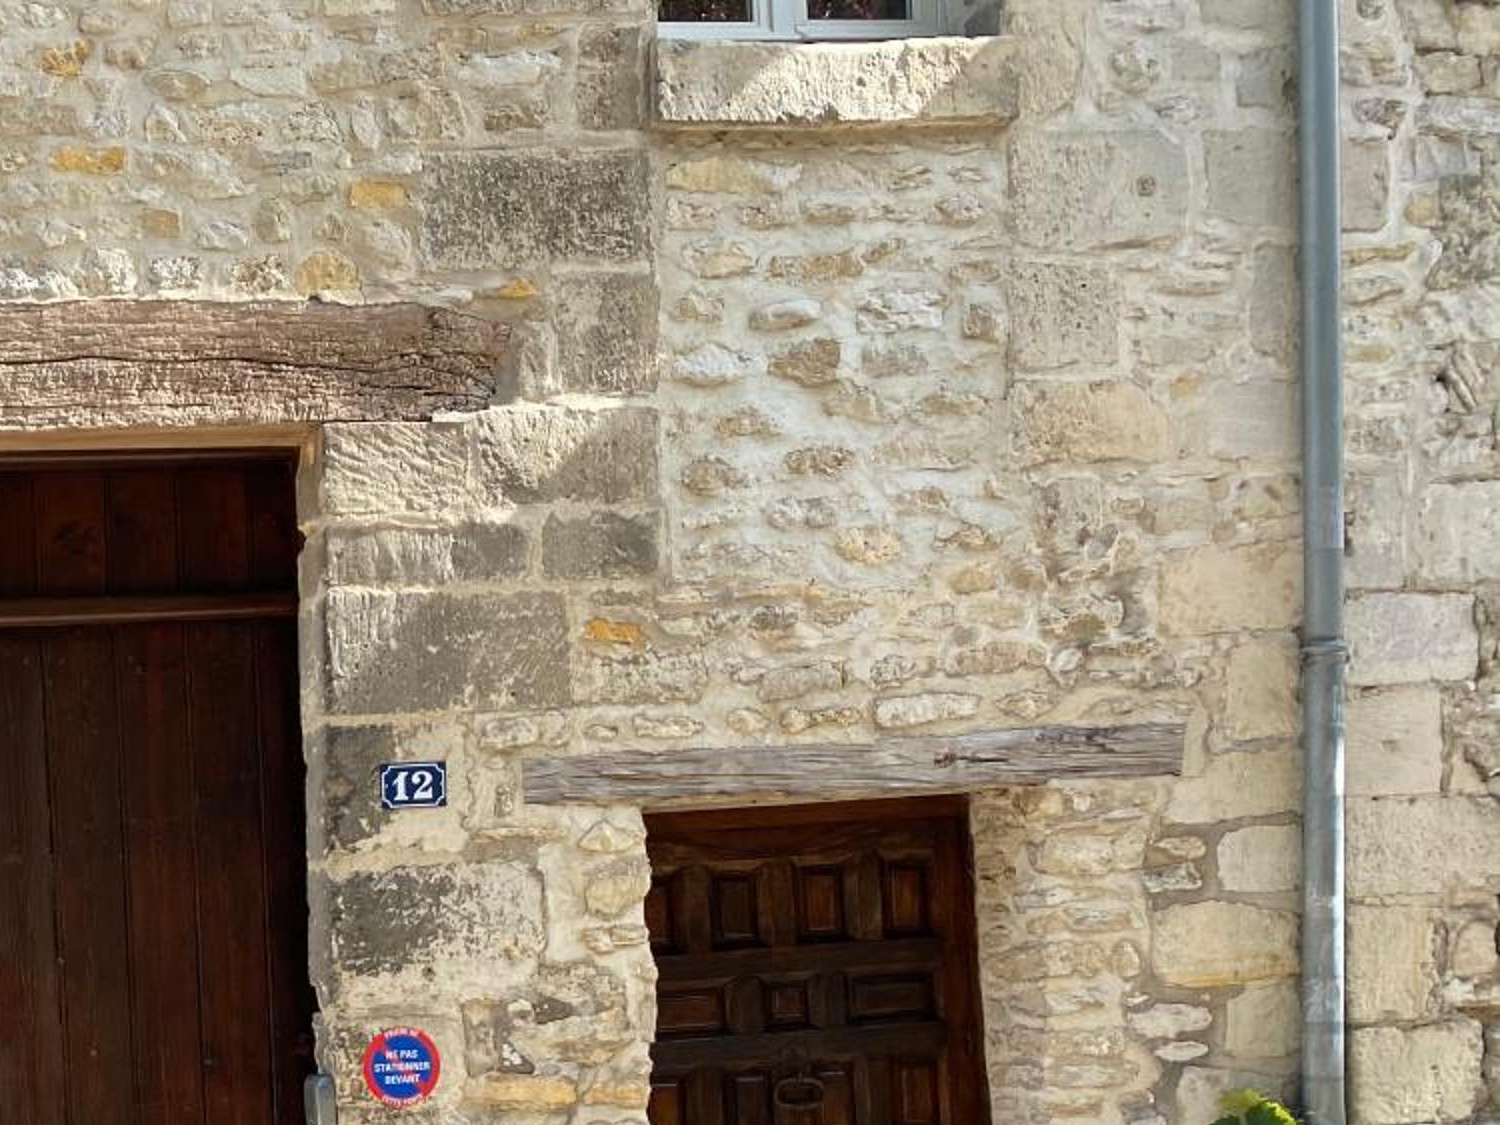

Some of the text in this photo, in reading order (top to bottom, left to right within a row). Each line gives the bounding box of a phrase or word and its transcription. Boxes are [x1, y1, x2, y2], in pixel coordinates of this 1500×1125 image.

[392, 770, 433, 801] 12
[385, 1049, 419, 1059] NE PAS
[374, 1061, 431, 1073] STATIONNER
[385, 1074, 421, 1085] DEVANT
